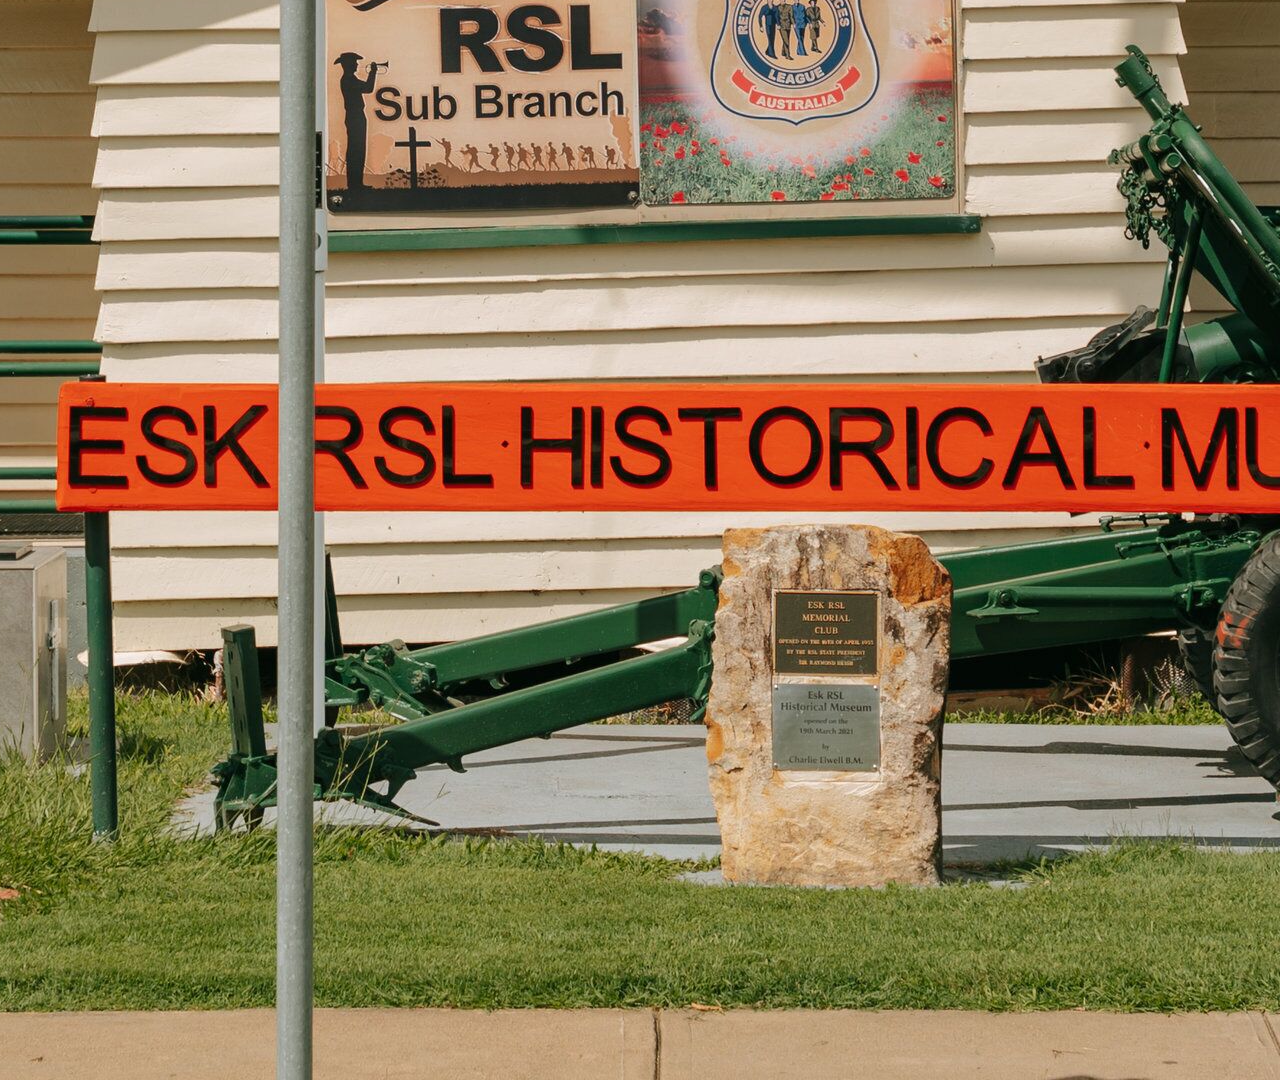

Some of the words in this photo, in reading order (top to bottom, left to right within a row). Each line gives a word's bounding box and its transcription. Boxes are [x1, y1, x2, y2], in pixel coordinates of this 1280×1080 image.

[439, 4, 624, 74] RSL
[767, 67, 825, 85] LEAGUE
[374, 85, 458, 122] Sub
[474, 80, 625, 120] Branch
[756, 93, 837, 111] AUSTRALIA
[68, 404, 272, 490] ESK
[314, 404, 495, 491] RSL
[520, 404, 1136, 493] HISTORICAL
[807, 601, 825, 610] ESK
[828, 601, 846, 610] RSL
[802, 613, 851, 622] MEMORIAL
[814, 626, 839, 635] CLUB
[808, 690, 824, 700] Esk
[827, 690, 845, 700] RSL
[780, 702, 827, 712] Historical
[829, 702, 872, 712] Museum
[815, 727, 837, 735] March
[837, 727, 854, 735] 2021
[821, 743, 830, 751] by
[788, 755, 818, 764] Charlie
